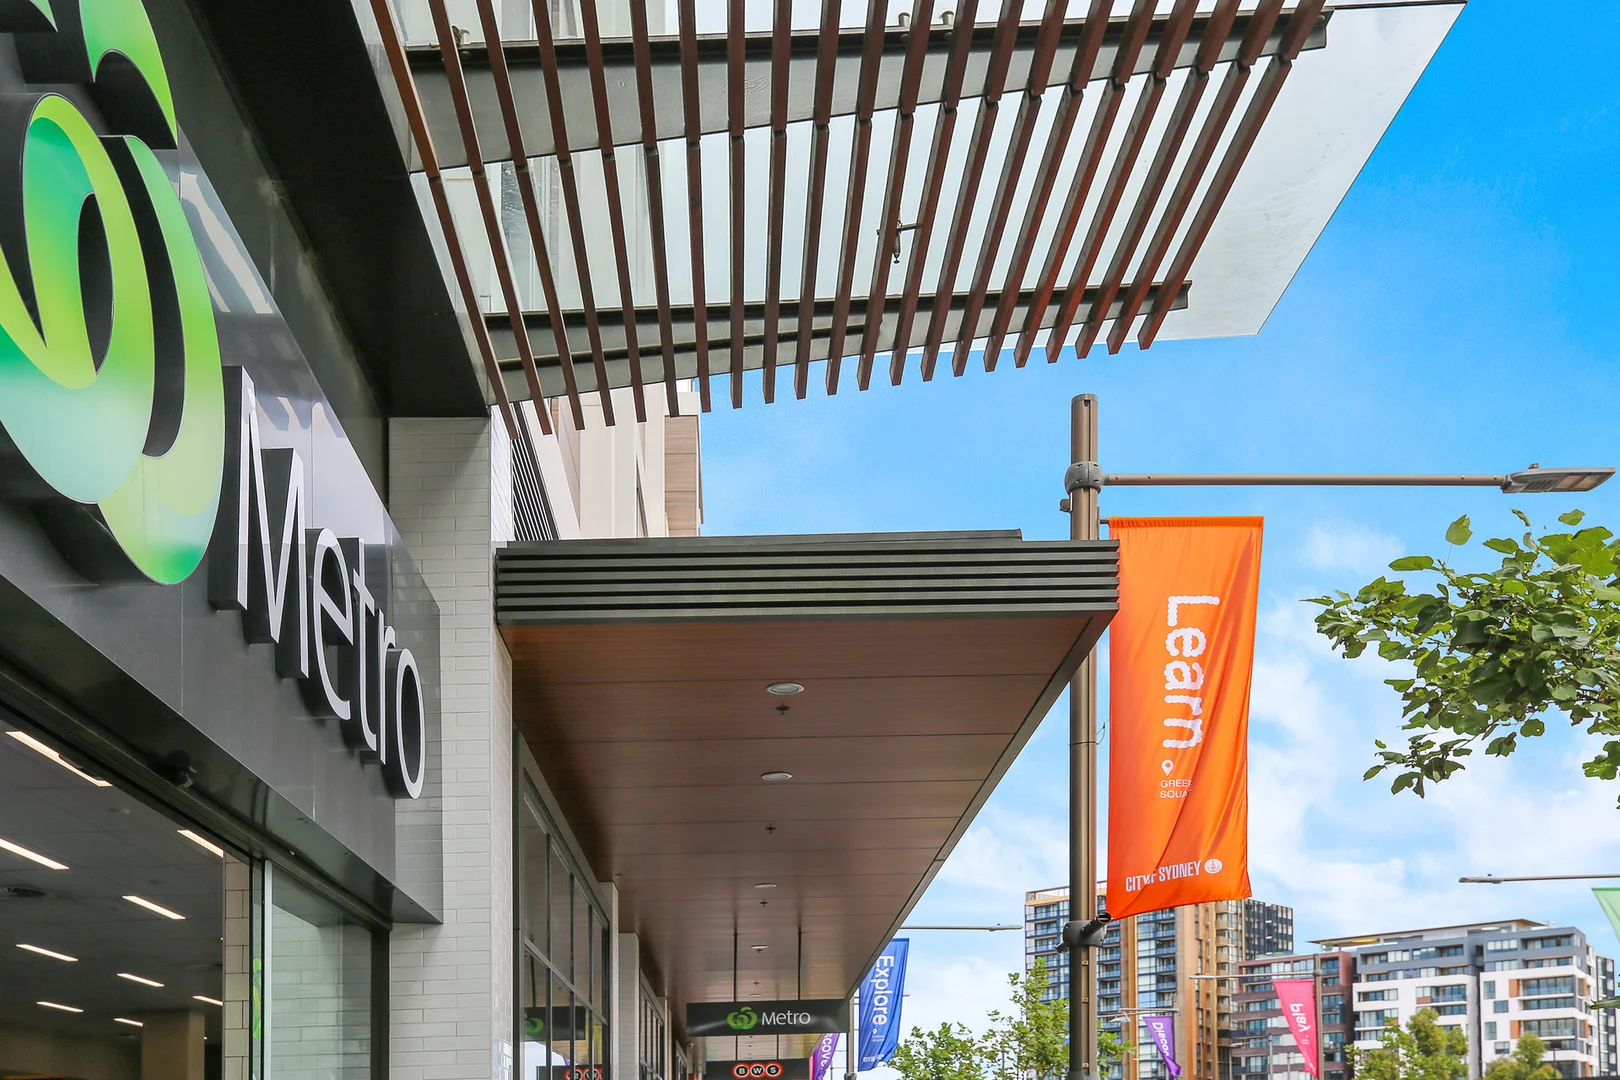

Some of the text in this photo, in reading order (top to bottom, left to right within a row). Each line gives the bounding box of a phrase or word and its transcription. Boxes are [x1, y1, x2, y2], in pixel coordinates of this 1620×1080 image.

[237, 365, 426, 799] Metro
[1163, 595, 1220, 749] Learn
[1160, 789, 1190, 798] SQUA
[1125, 875, 1149, 892] CITY
[1158, 860, 1202, 882] SYDNEY
[870, 955, 895, 1025] Explore
[761, 1010, 811, 1026] Metro
[737, 1065, 777, 1075] BWS
